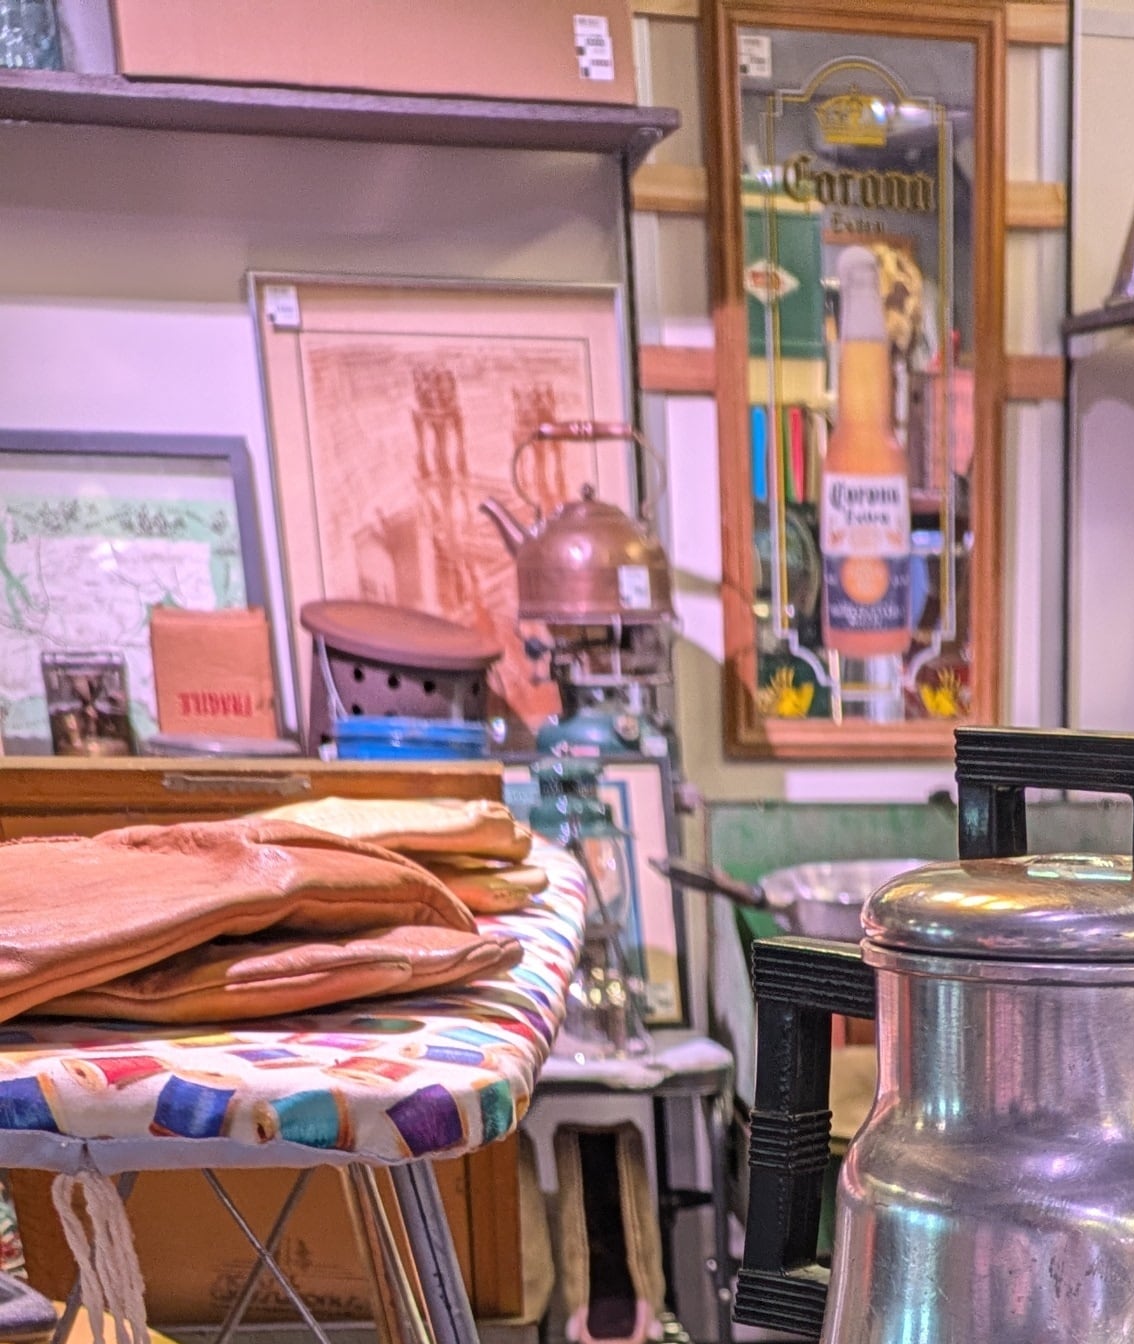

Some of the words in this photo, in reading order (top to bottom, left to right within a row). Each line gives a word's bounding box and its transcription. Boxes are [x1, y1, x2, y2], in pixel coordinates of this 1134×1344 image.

[783, 154, 935, 213] Corona
[830, 482, 898, 510] Corona
[178, 692, 252, 718] FRAGILE
